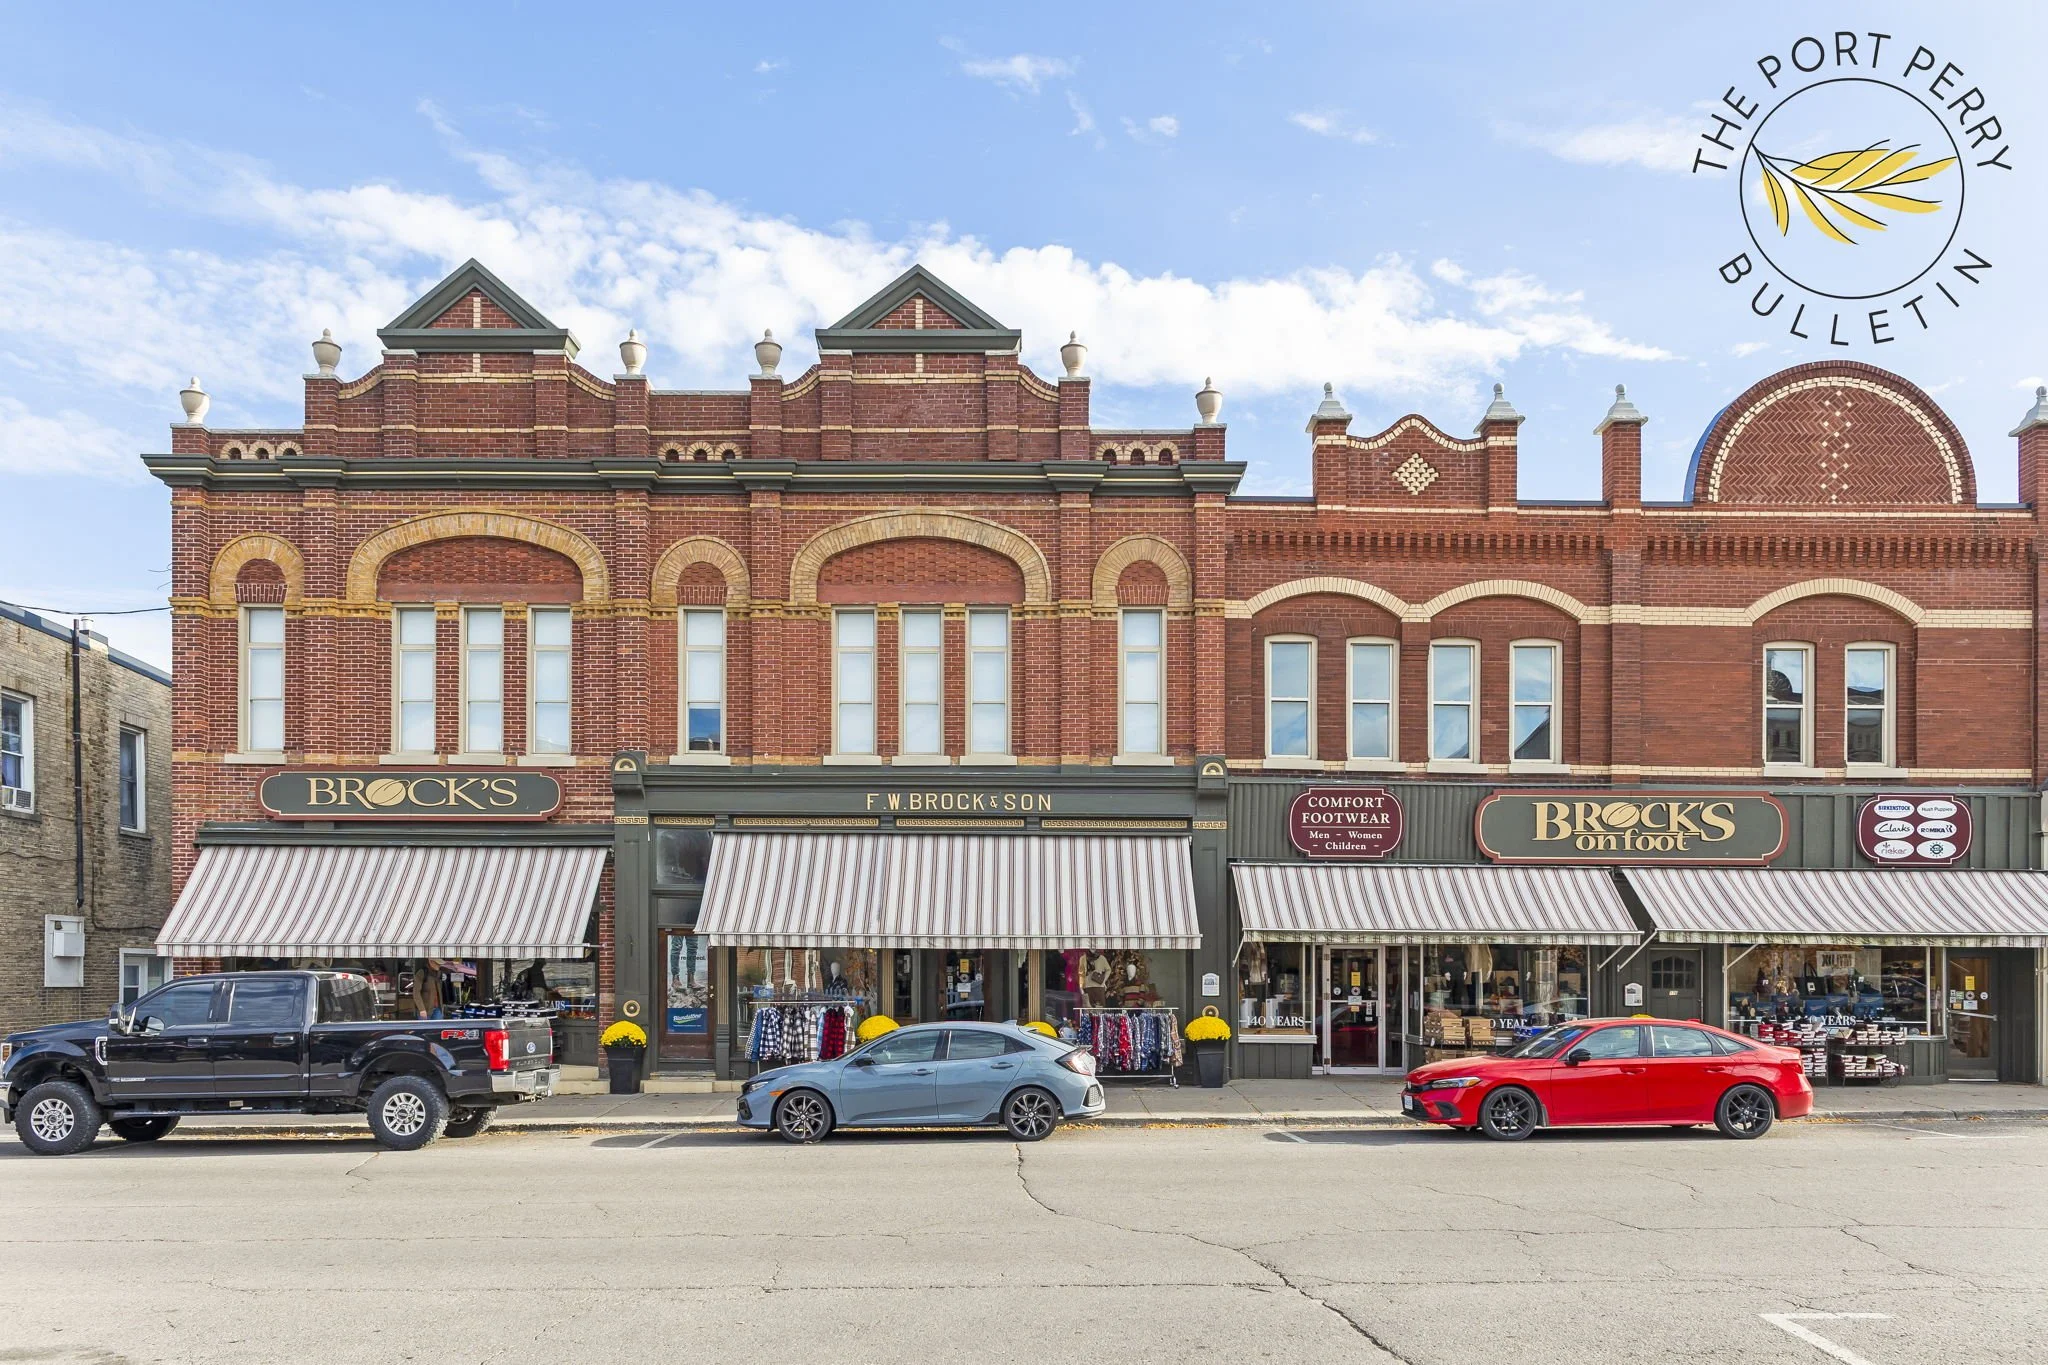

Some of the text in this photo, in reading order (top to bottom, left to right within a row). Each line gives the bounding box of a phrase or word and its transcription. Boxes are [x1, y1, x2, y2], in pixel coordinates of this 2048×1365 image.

[306, 777, 518, 810] BROCK'S
[1003, 793, 1052, 811] SON
[1308, 796, 1385, 808] COMFORT
[1301, 812, 1390, 824] FOOTWEAR
[1531, 801, 1736, 842] BROCK'S
[1878, 823, 1911, 833] Clarks
[1309, 830, 1330, 839] Men
[1348, 830, 1383, 839] Women
[1575, 828, 1690, 851] on foot
[1325, 841, 1367, 850] Children
[544, 1000, 566, 1011] EARS
[1247, 1015, 1305, 1027] 140 YEARS
[1499, 1018, 1528, 1029] YEAR
[1820, 1015, 1856, 1026] YEARS
